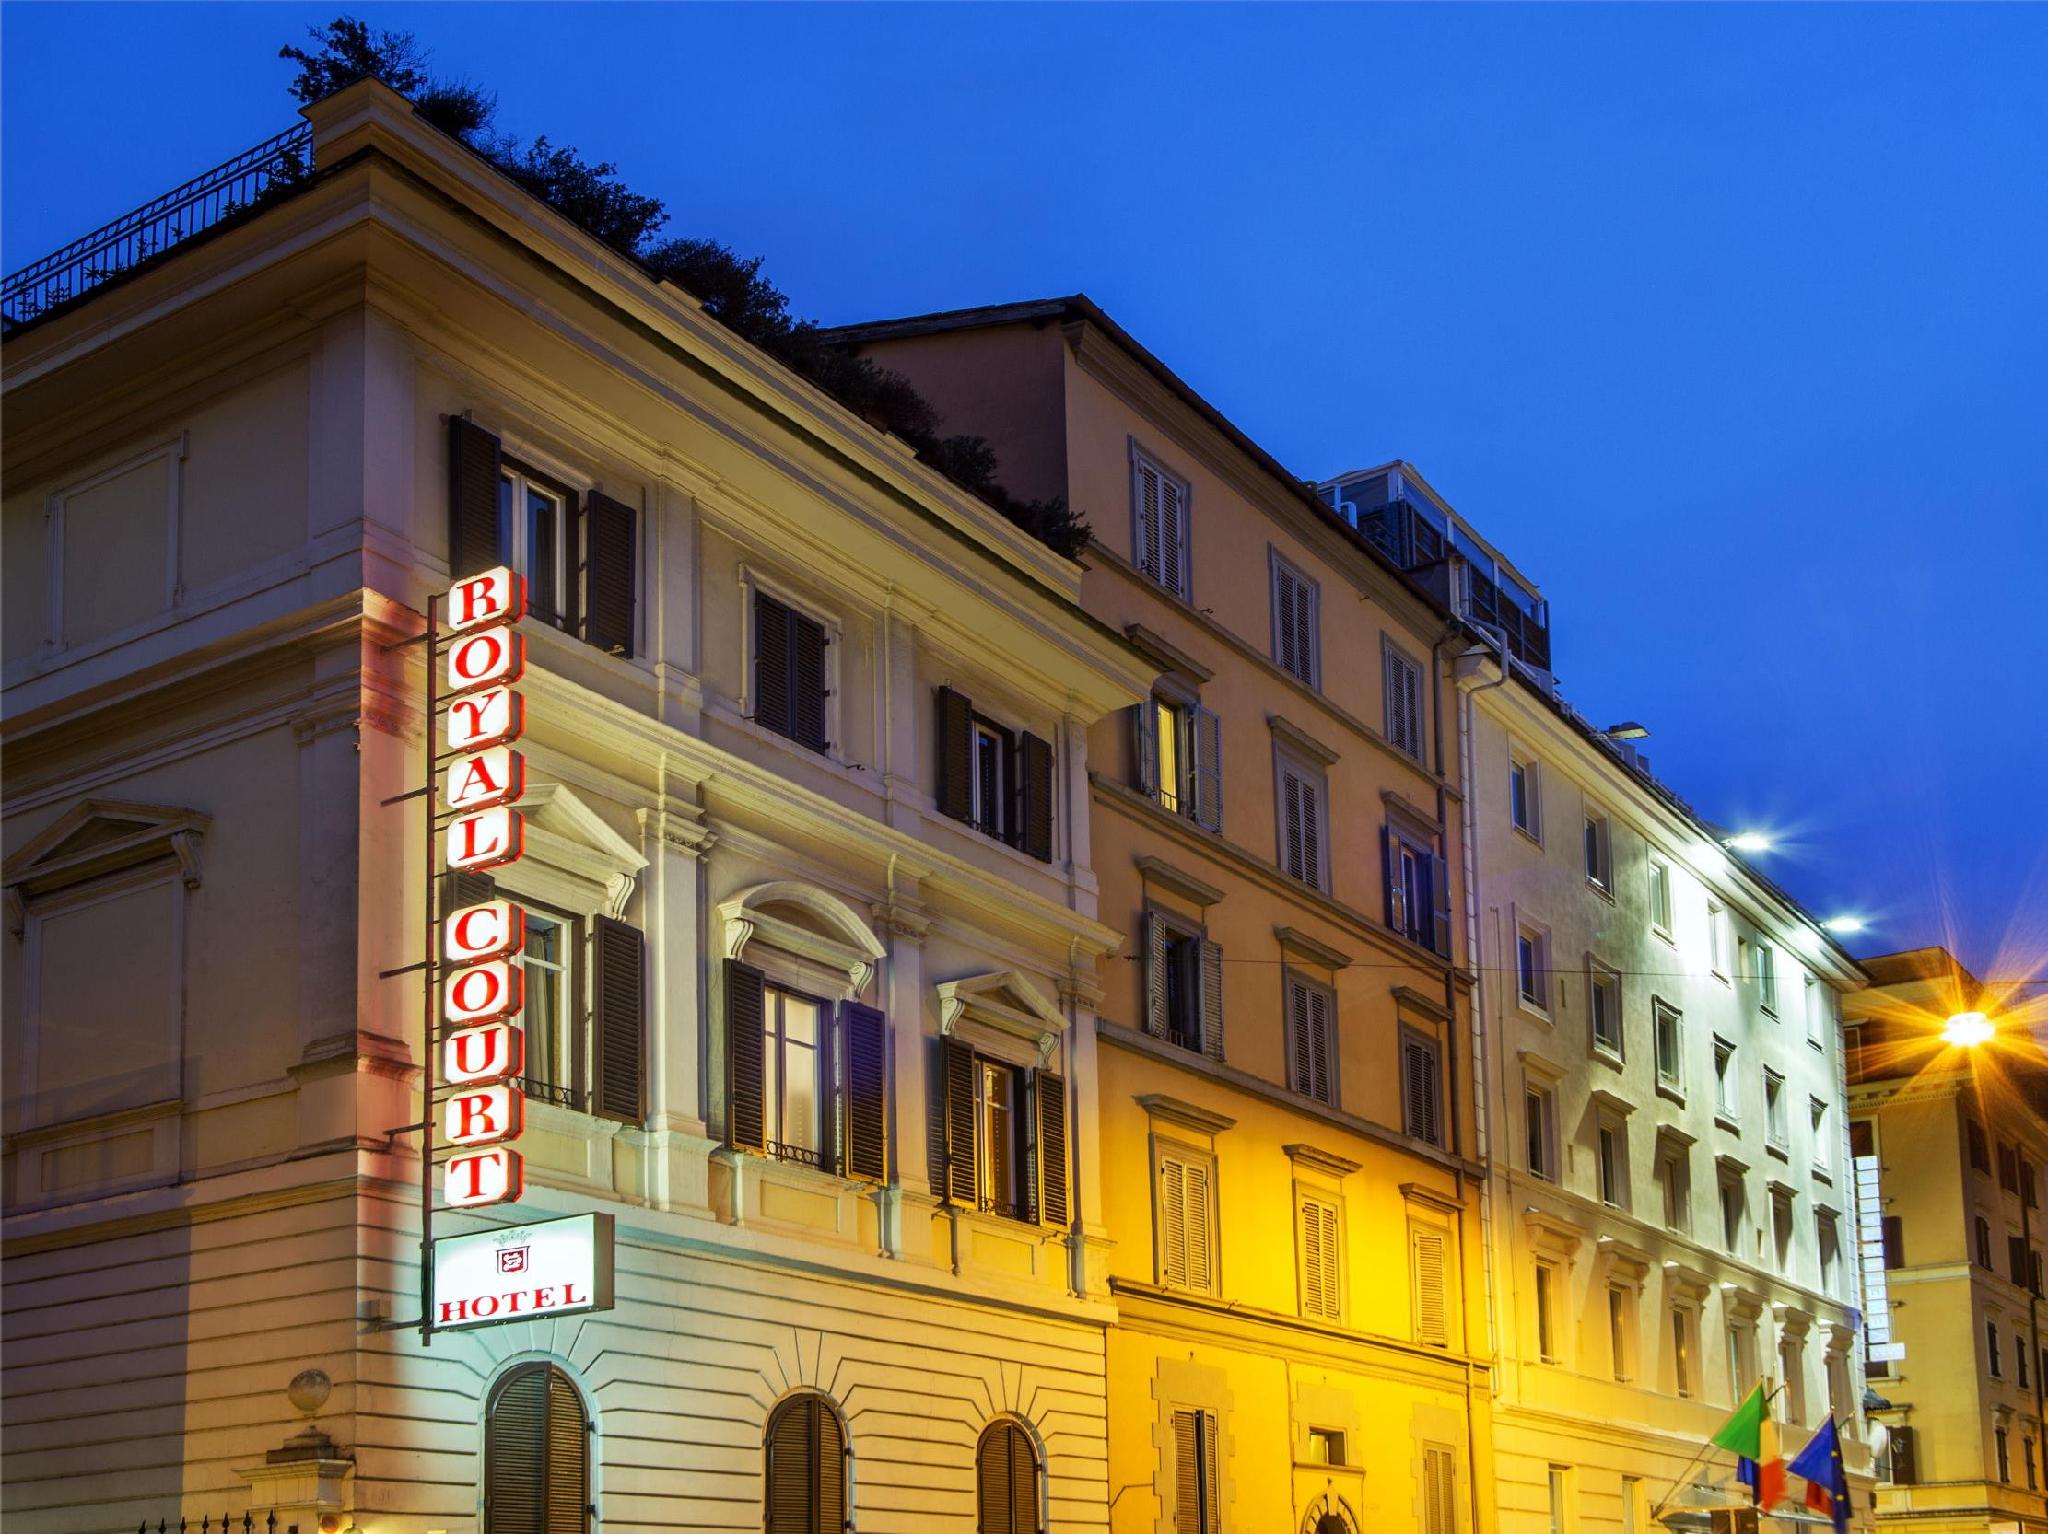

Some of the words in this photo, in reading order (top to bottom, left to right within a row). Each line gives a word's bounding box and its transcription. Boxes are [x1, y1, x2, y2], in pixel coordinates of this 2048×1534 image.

[452, 576, 502, 861] ROYAL
[449, 908, 502, 1198] COURT
[439, 1284, 586, 1322] HOTEL
